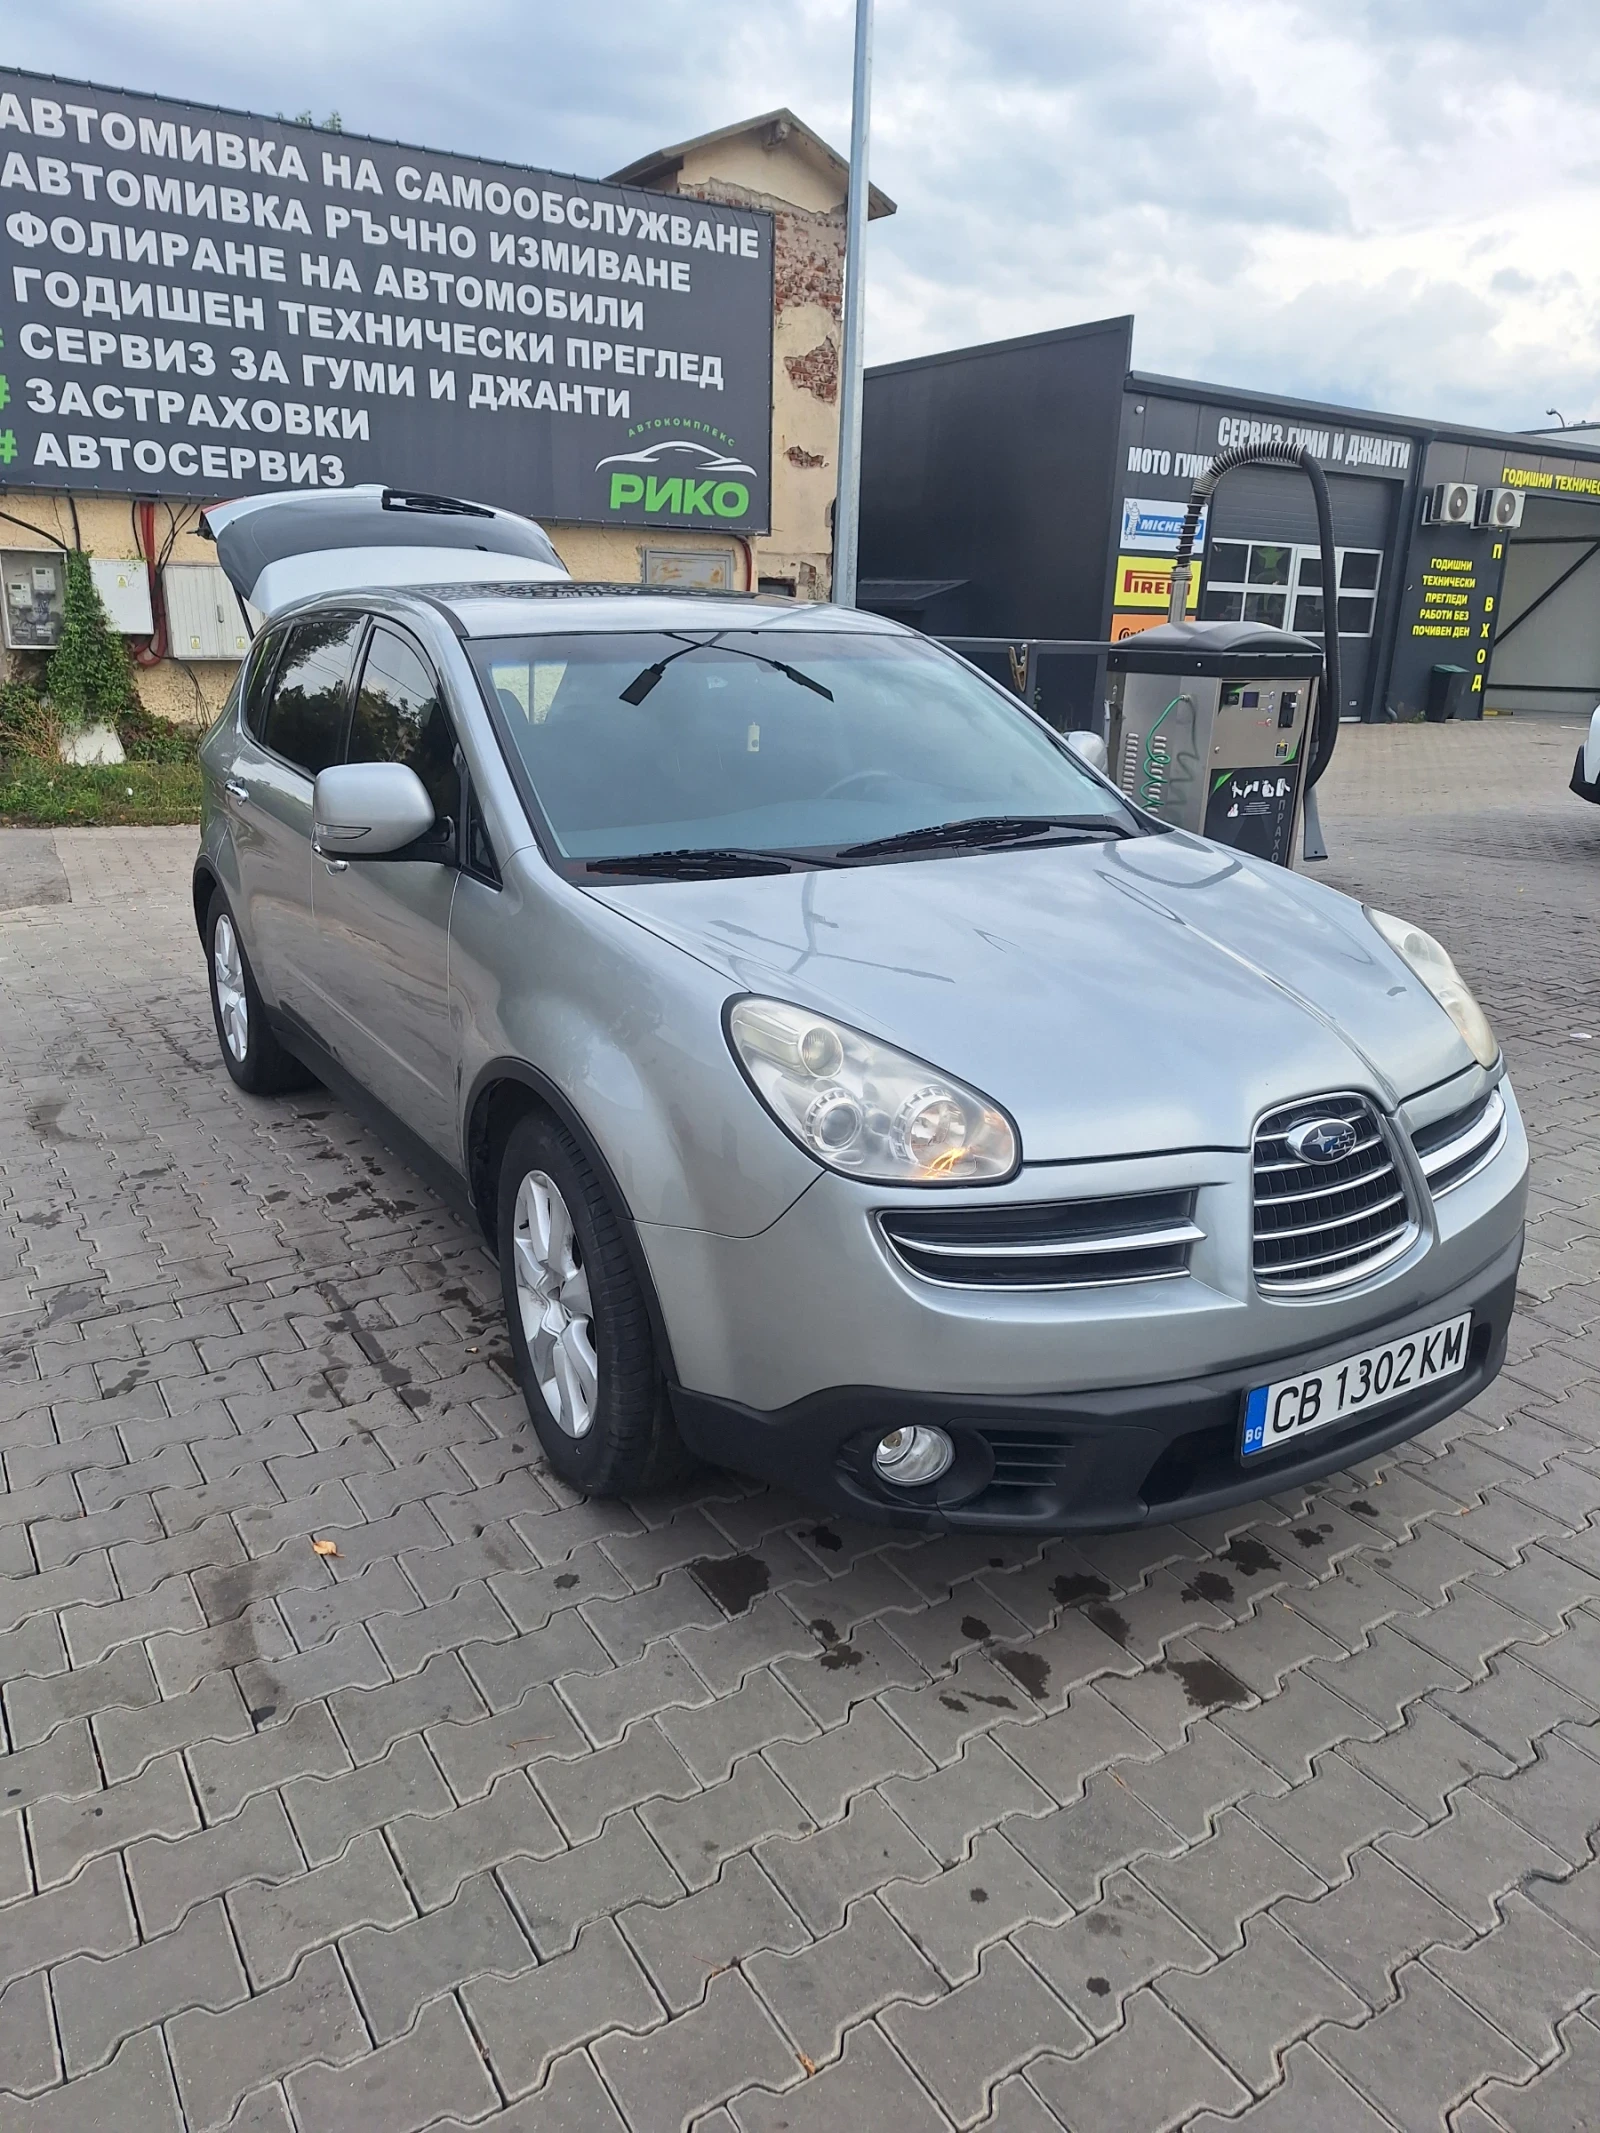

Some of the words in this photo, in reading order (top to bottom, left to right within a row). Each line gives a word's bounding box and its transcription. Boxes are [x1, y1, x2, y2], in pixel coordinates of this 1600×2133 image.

[0, 92, 309, 182] АВТОМИВКА
[322, 151, 384, 195] НА
[395, 166, 760, 259] САМООБСЛУЖВАНЕ
[0, 151, 313, 235] АВТОМИВКА
[325, 204, 477, 259] РЪЧНО
[489, 231, 692, 293] ИЗМИВАНЕ
[6, 210, 287, 282] ФОЛИРАНЕ
[300, 252, 362, 293] НА
[374, 264, 644, 331] АВТОМОБИЛИ
[13, 266, 265, 331] ГОДИШЕН
[278, 300, 554, 364] ТЕХНИЧЕСКИ
[566, 337, 724, 391] ПРЕГЛЕД
[19, 323, 216, 376] СЕРВИЗ
[230, 346, 290, 384] ЗА
[302, 354, 415, 397] ГУМИ
[429, 368, 456, 401] И
[468, 373, 630, 419] ДЖАНТИ
[25, 378, 370, 441] ЗАСТРАХОВКИ
[628, 417, 736, 447] АВТОКОМПЛЕКС
[33, 432, 346, 486] АВТОСЕРВИЗ
[1127, 446, 1171, 476] МОТО
[1331, 432, 1345, 460] И
[1345, 434, 1411, 469] ДЖАНТИ
[1502, 467, 1554, 489] ГОДИШНИ
[609, 472, 750, 518] РИКО
[1140, 519, 1202, 536] MICHE
[1430, 558, 1473, 571] ГОДИШНИ
[1123, 569, 1192, 595] PIREI
[1422, 575, 1476, 588] ТЕХНИЧЕСКИ
[1425, 592, 1468, 606] ПРЕГЛЕДИ
[1419, 609, 1452, 620] РАБОТИ
[1453, 611, 1469, 621] БЕЗ
[1412, 625, 1451, 637] ПОЧИВЕН
[1452, 627, 1470, 638] ДЕН
[1272, 1377, 1323, 1434] CB
[1336, 1342, 1415, 1411] 1302
[1419, 1321, 1466, 1379] KM
[1245, 1428, 1262, 1444] BG
